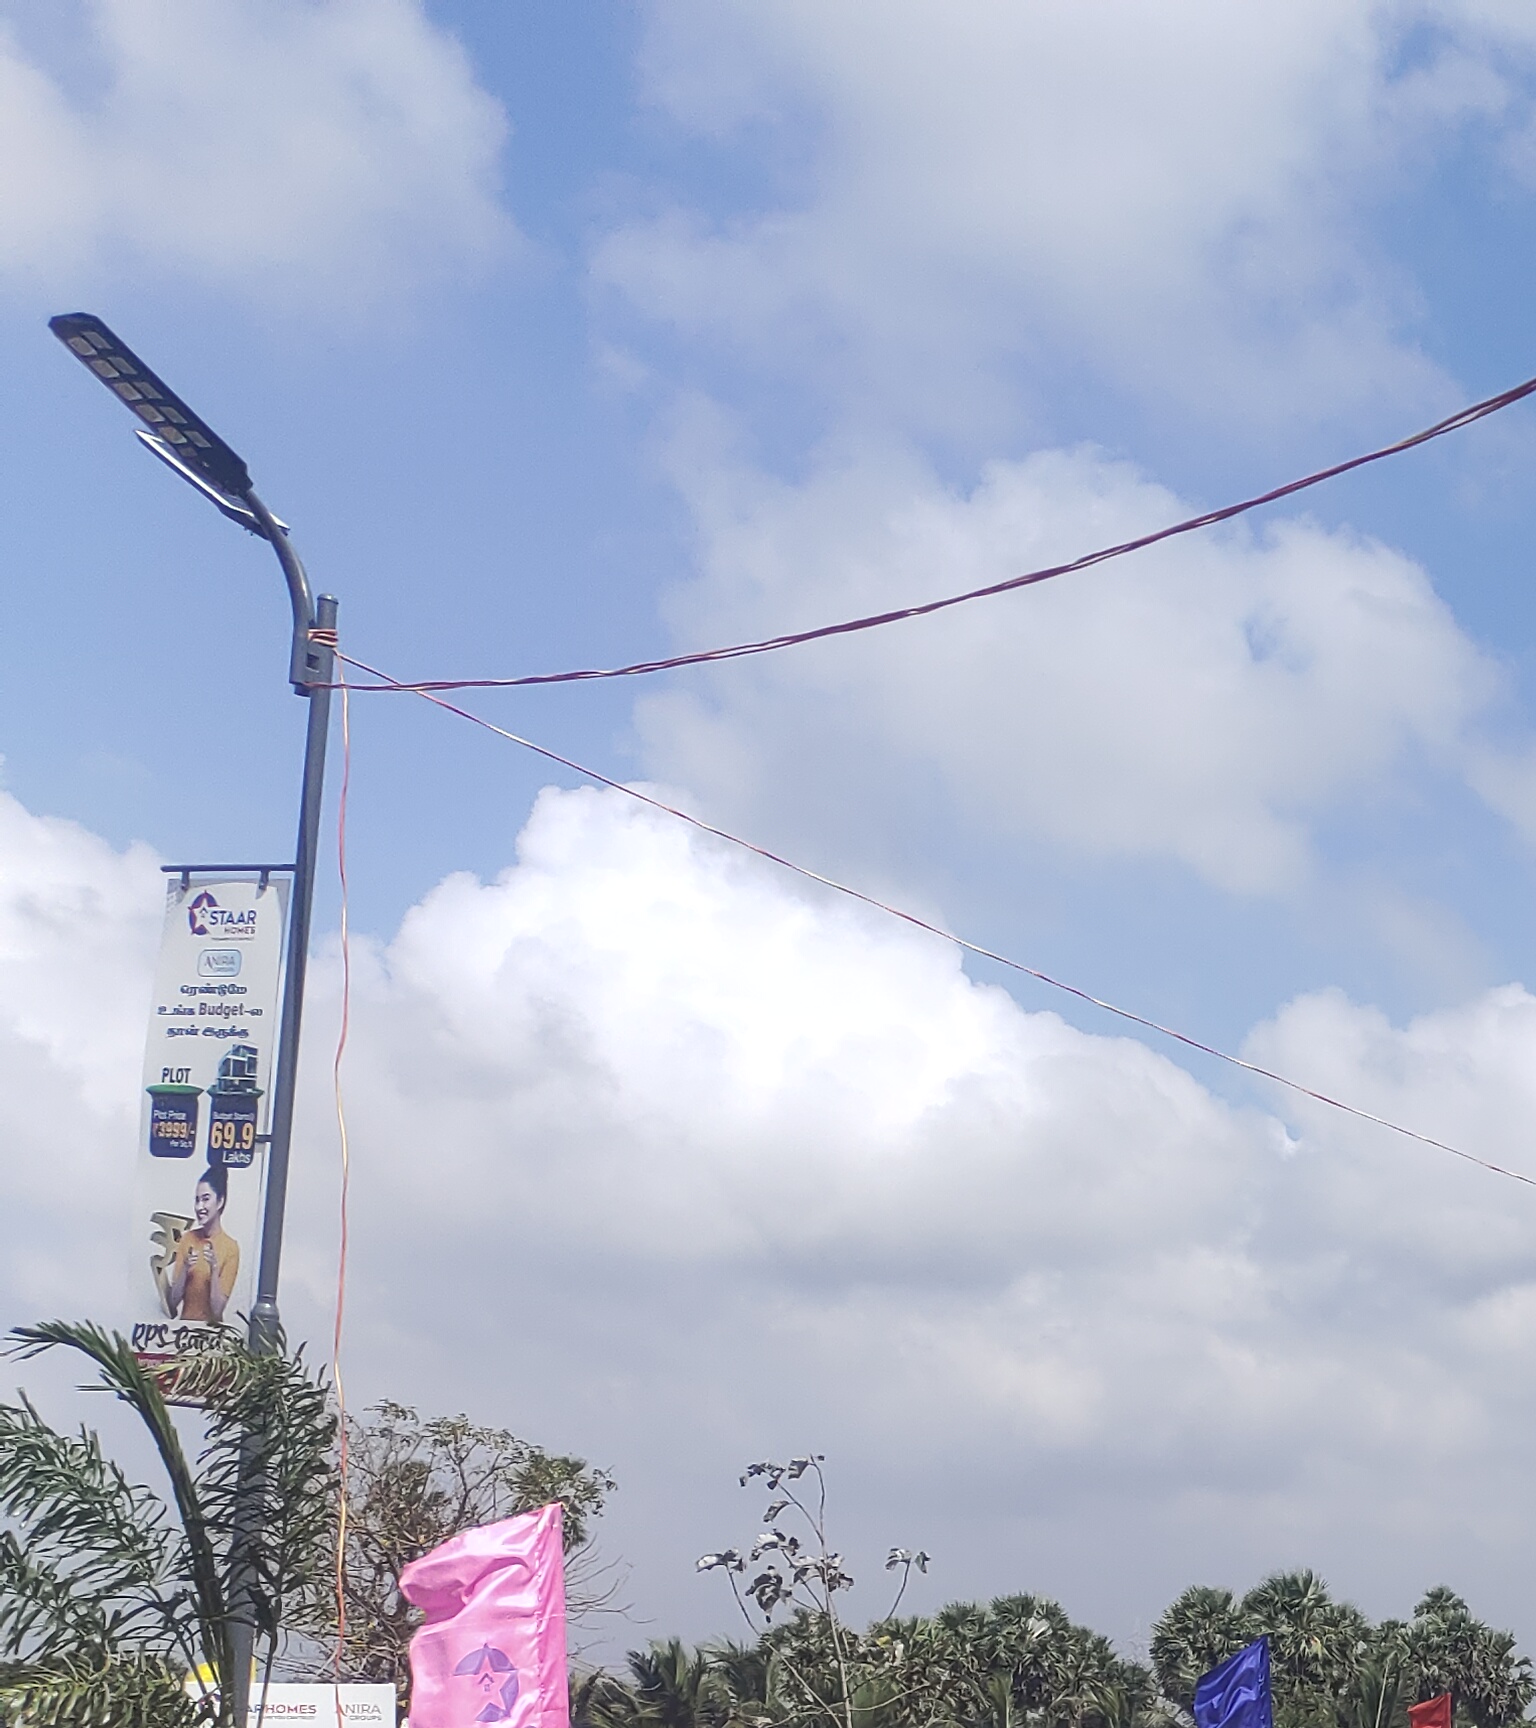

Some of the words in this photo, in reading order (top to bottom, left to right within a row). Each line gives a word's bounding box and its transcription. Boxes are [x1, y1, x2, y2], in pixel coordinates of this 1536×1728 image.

[209, 908, 257, 926] STAAR
[224, 926, 256, 935] HOMES
[161, 1067, 192, 1084] PLOT
[210, 1121, 254, 1150] 69.9
[222, 1151, 251, 1163] Lakhs
[132, 1322, 171, 1351] RPS
